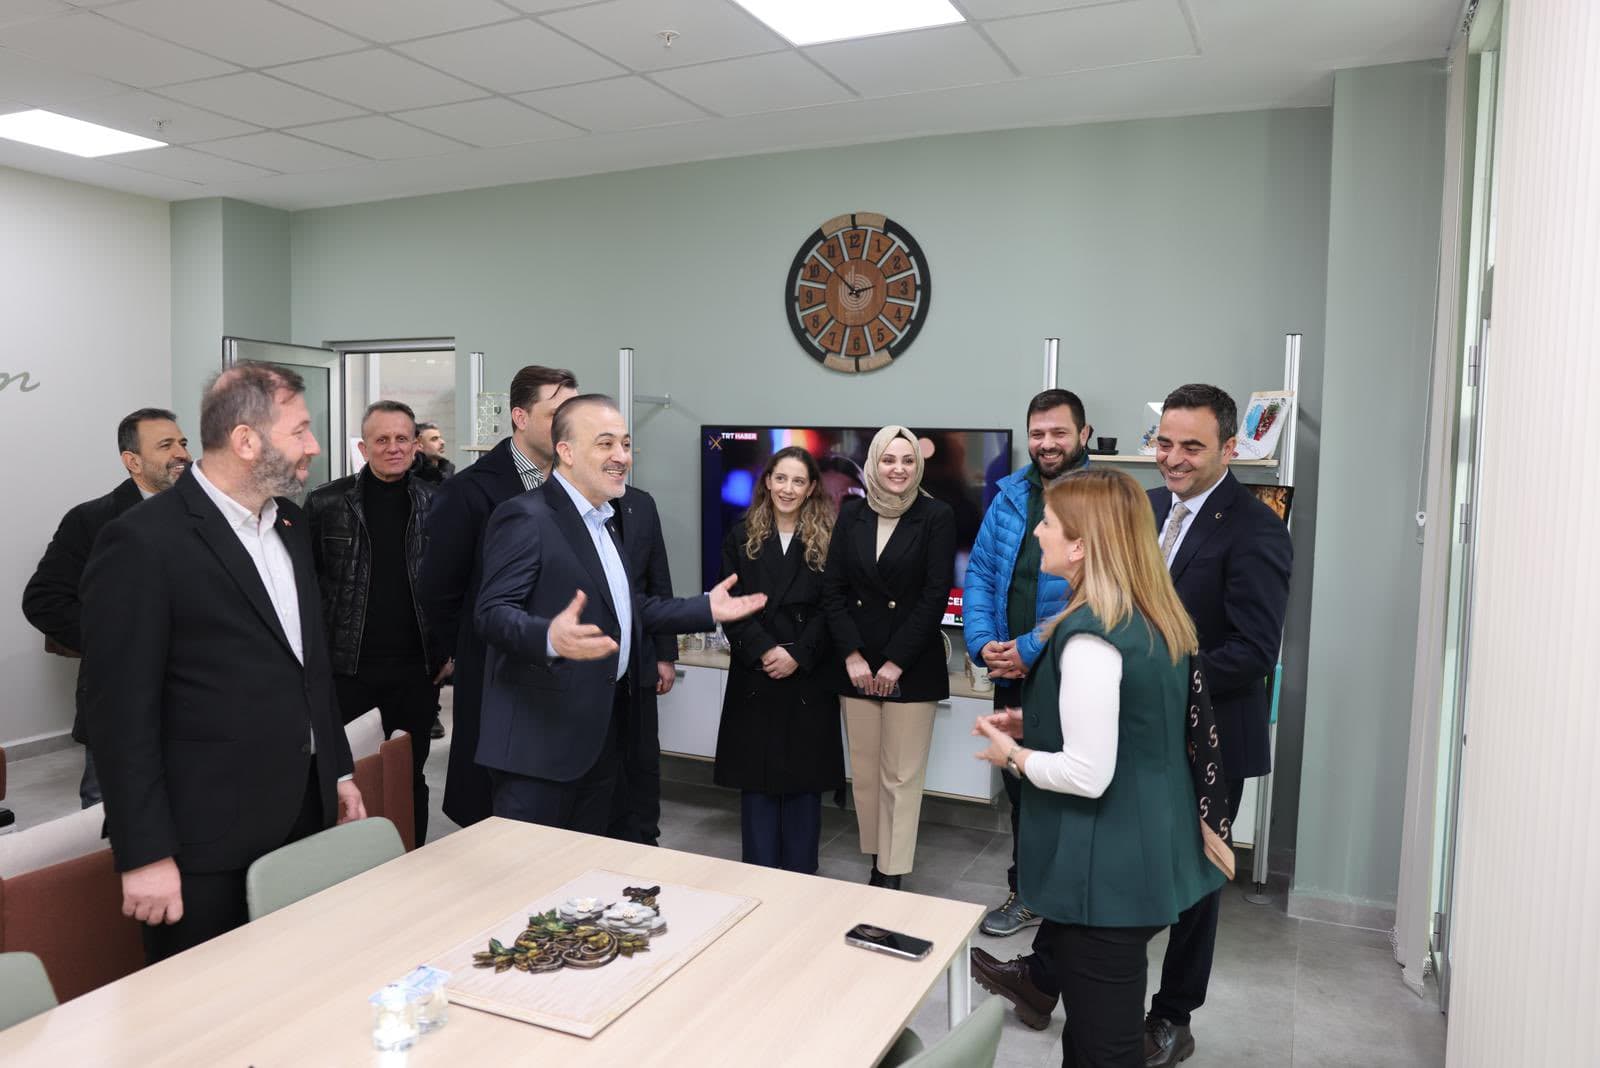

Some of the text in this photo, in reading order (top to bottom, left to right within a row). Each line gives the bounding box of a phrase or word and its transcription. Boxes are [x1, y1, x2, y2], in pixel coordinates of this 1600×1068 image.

[849, 234, 860, 248] 12
[875, 239, 881, 252] 1
[827, 244, 836, 258] 11
[893, 255, 901, 270] 2
[809, 264, 821, 278] 10
[900, 281, 908, 295] 3
[805, 289, 813, 304] 9
[894, 307, 903, 321] 4
[812, 315, 820, 328] 8
[829, 331, 836, 346] 7
[877, 328, 885, 342] 5
[853, 337, 860, 351] 6
[735, 432, 757, 440] HABER
